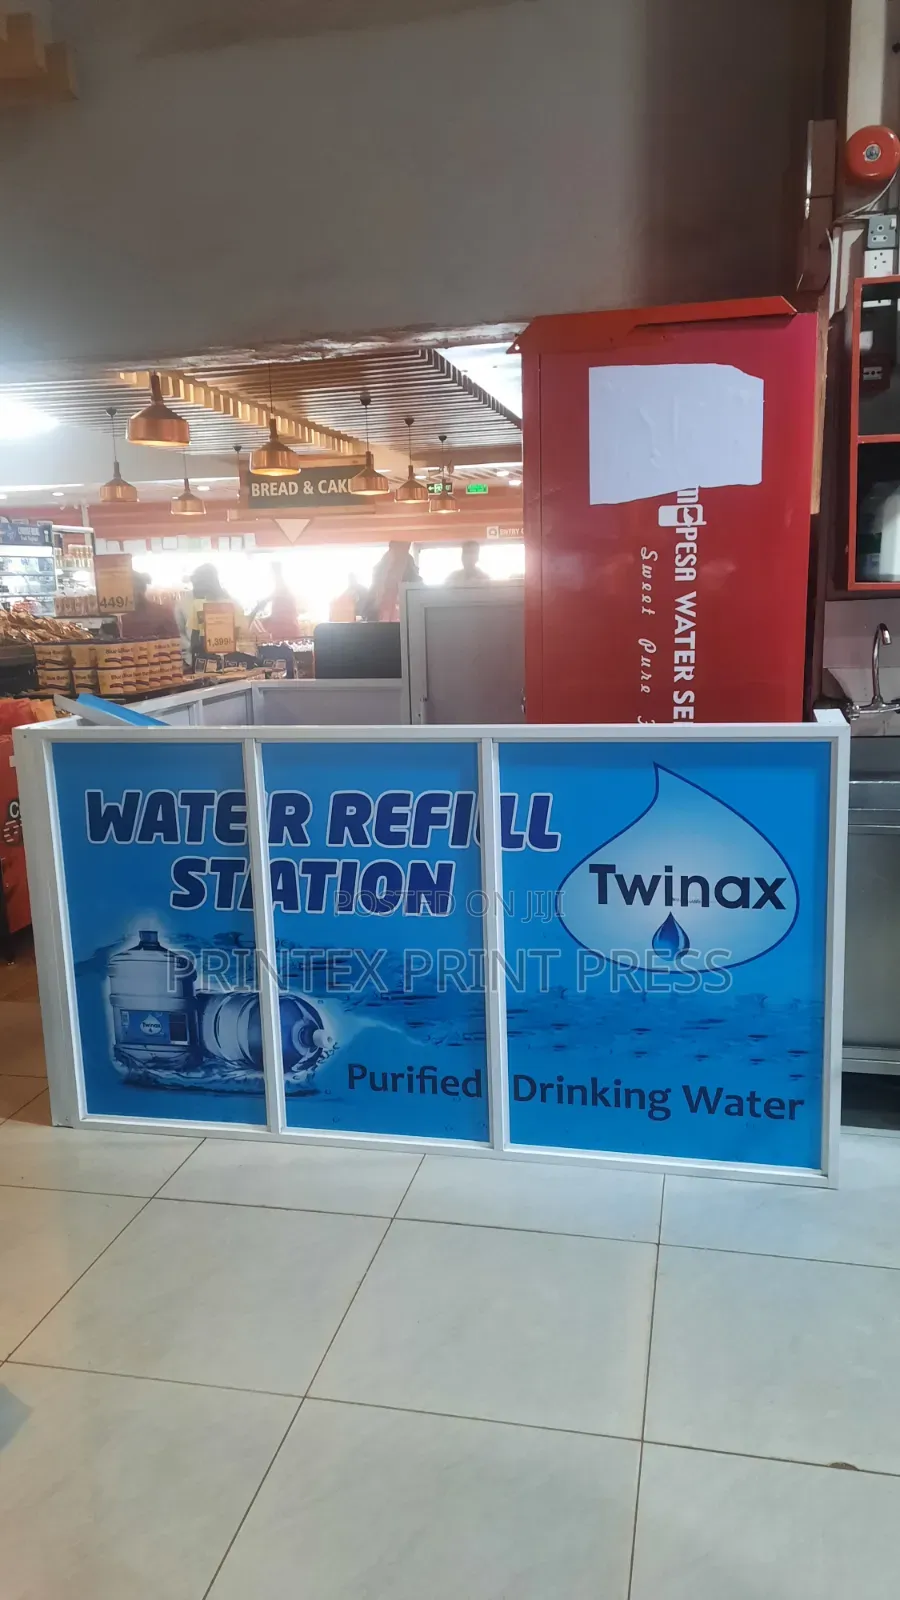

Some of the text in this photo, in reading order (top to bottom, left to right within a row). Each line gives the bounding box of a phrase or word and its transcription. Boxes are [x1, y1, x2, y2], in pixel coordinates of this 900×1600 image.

[251, 481, 299, 497] BREAD
[303, 480, 314, 495] &
[641, 547, 658, 615] Sweet
[638, 638, 657, 694] Pure
[674, 591, 697, 683] WATER
[673, 691, 695, 724] SE
[85, 789, 562, 852] WATER REFILL
[170, 855, 456, 917] STATION
[589, 863, 787, 910] Twinax
[348, 1063, 805, 1121] Purified Drinking Water
